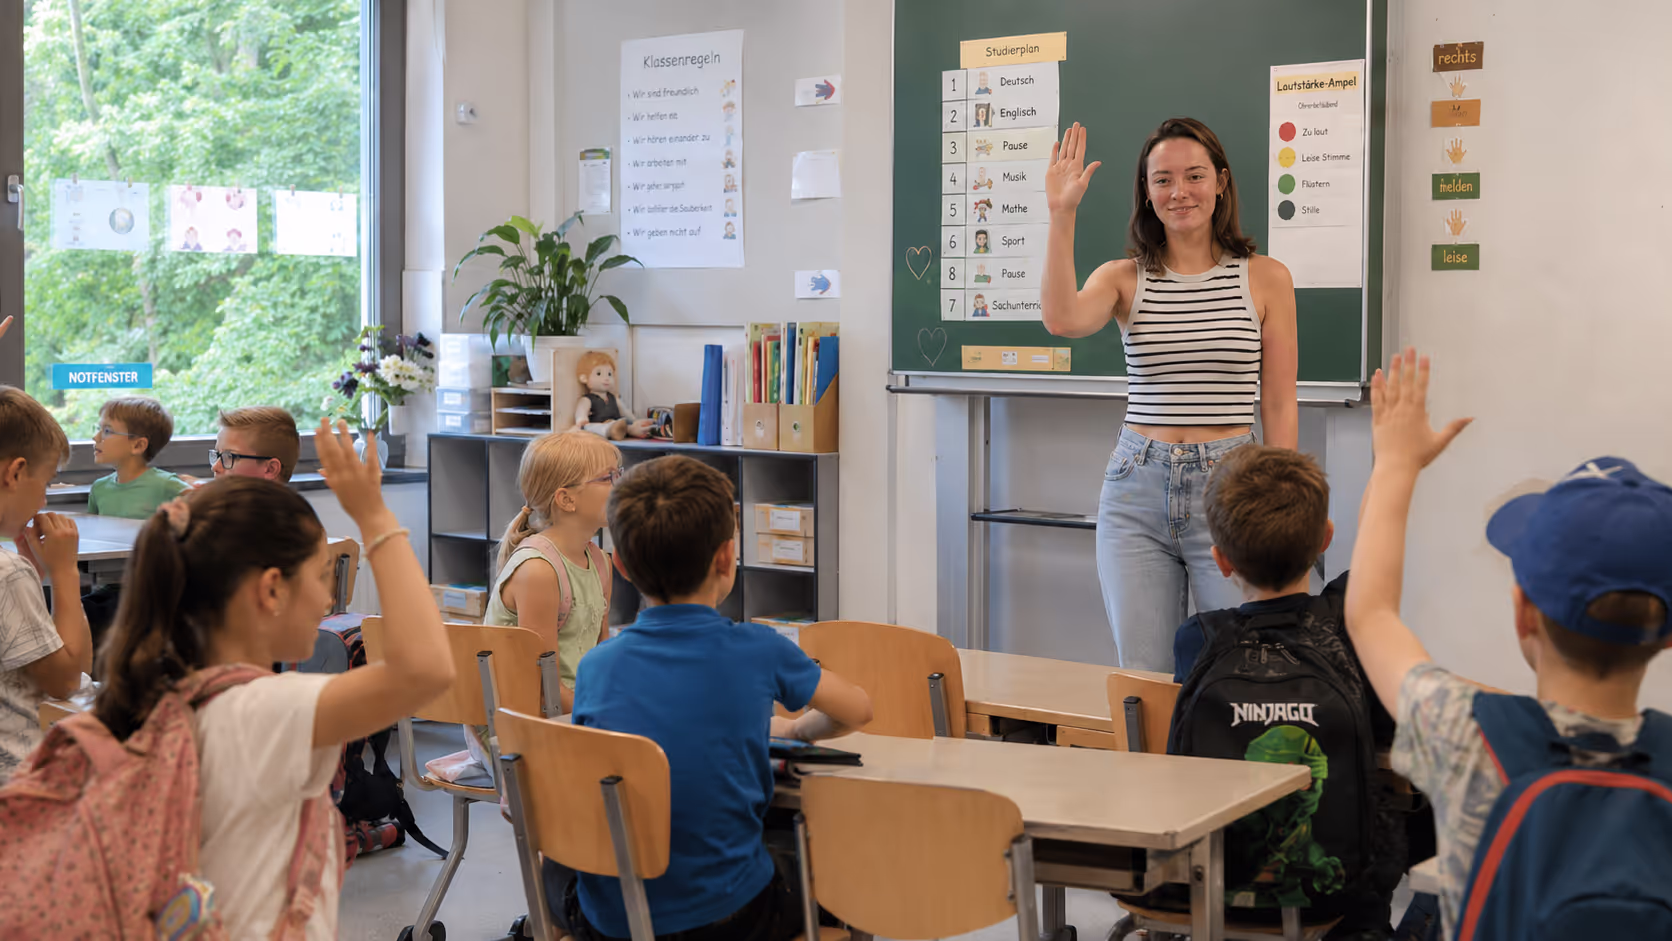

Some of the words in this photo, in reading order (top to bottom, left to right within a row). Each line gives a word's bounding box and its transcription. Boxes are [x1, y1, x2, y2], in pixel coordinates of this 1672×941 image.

[985, 44, 1040, 57] Studierplan
[1438, 49, 1477, 64] rechts
[643, 50, 721, 69] Klassenregeln
[951, 78, 956, 91] 1
[1000, 75, 1035, 86] Deutsch
[1277, 76, 1357, 91] Lautstärke-Ampel
[950, 110, 957, 123] 2
[1000, 107, 1037, 120] Englisch
[1302, 128, 1313, 136] Zu
[1314, 127, 1328, 136] laut
[950, 141, 957, 154] 3
[1003, 141, 1028, 150] Pause
[1301, 154, 1320, 162] Leise
[1322, 153, 1351, 161] Stimme
[949, 172, 957, 186] 4
[1002, 171, 1027, 182] Musik
[949, 203, 957, 217] 5
[1001, 204, 1028, 213] Mathe
[1301, 206, 1320, 214] Stille
[647, 228, 668, 239] geben
[669, 227, 687, 237] nicht
[688, 226, 701, 236] auf
[949, 235, 957, 249] 6
[1001, 235, 1025, 248] Sport
[1443, 249, 1468, 263] leise
[948, 266, 956, 281] 8
[1002, 269, 1026, 278] Pause
[949, 298, 956, 312] 7
[68, 371, 138, 383] NOTFENSTER
[1229, 702, 1320, 727] NINJAGO
